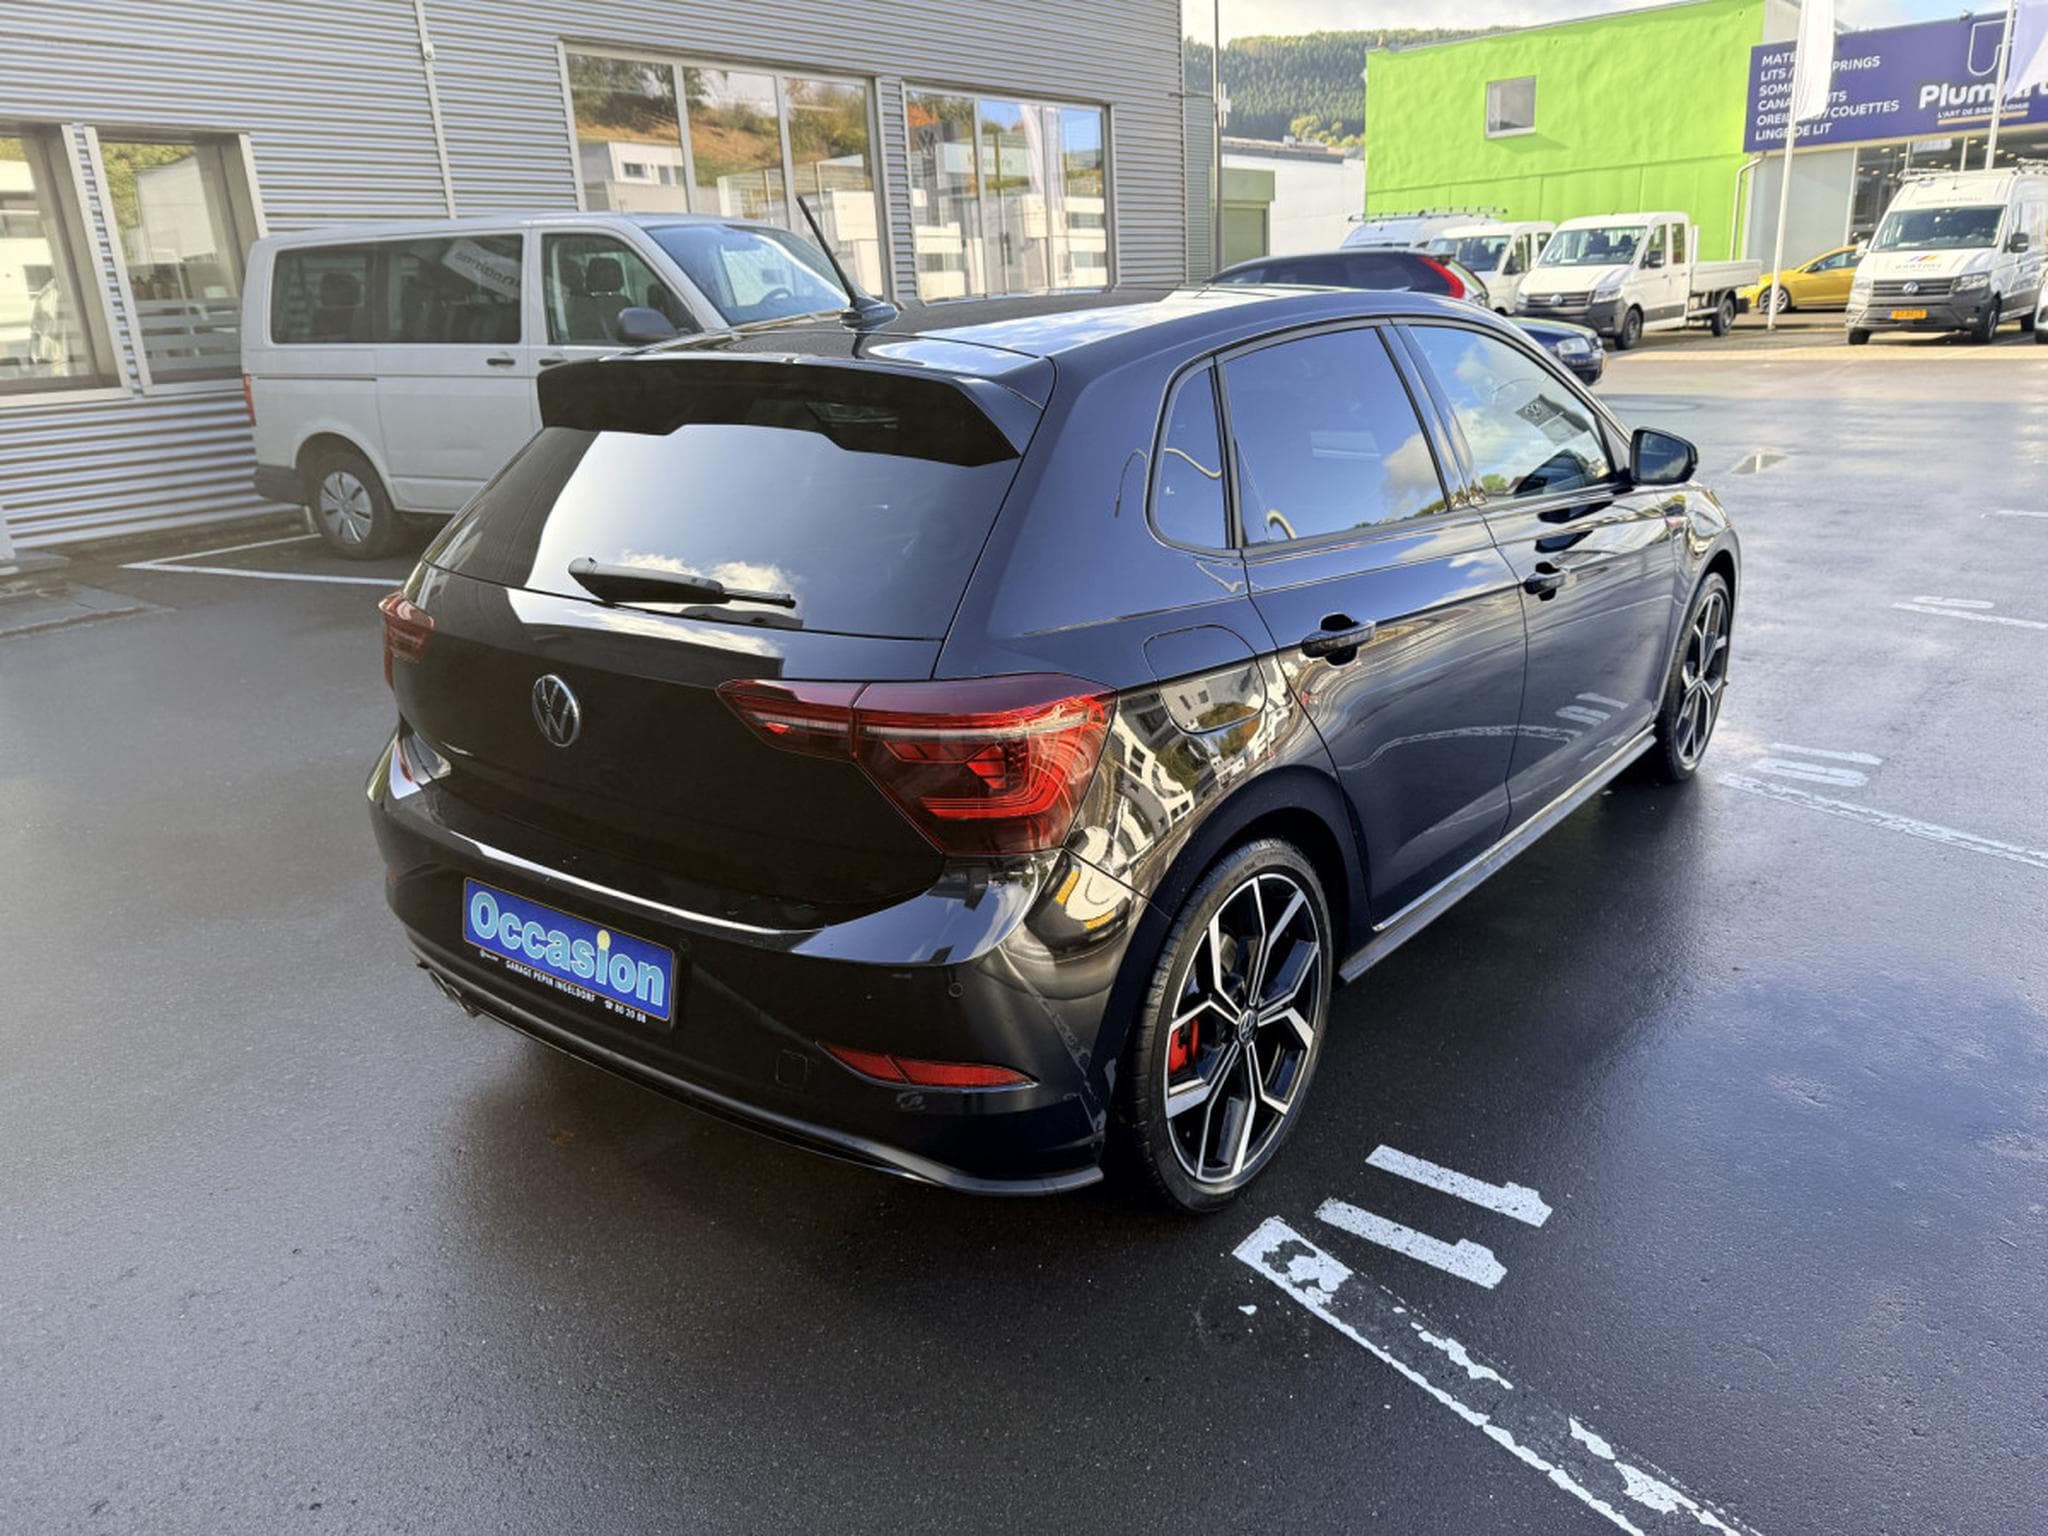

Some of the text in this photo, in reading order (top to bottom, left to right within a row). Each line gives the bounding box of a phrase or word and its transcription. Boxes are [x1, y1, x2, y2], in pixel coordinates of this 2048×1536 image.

[1812, 122, 1832, 135] LIT
[470, 891, 665, 1007] Occasion
[506, 959, 531, 977] GARAGE
